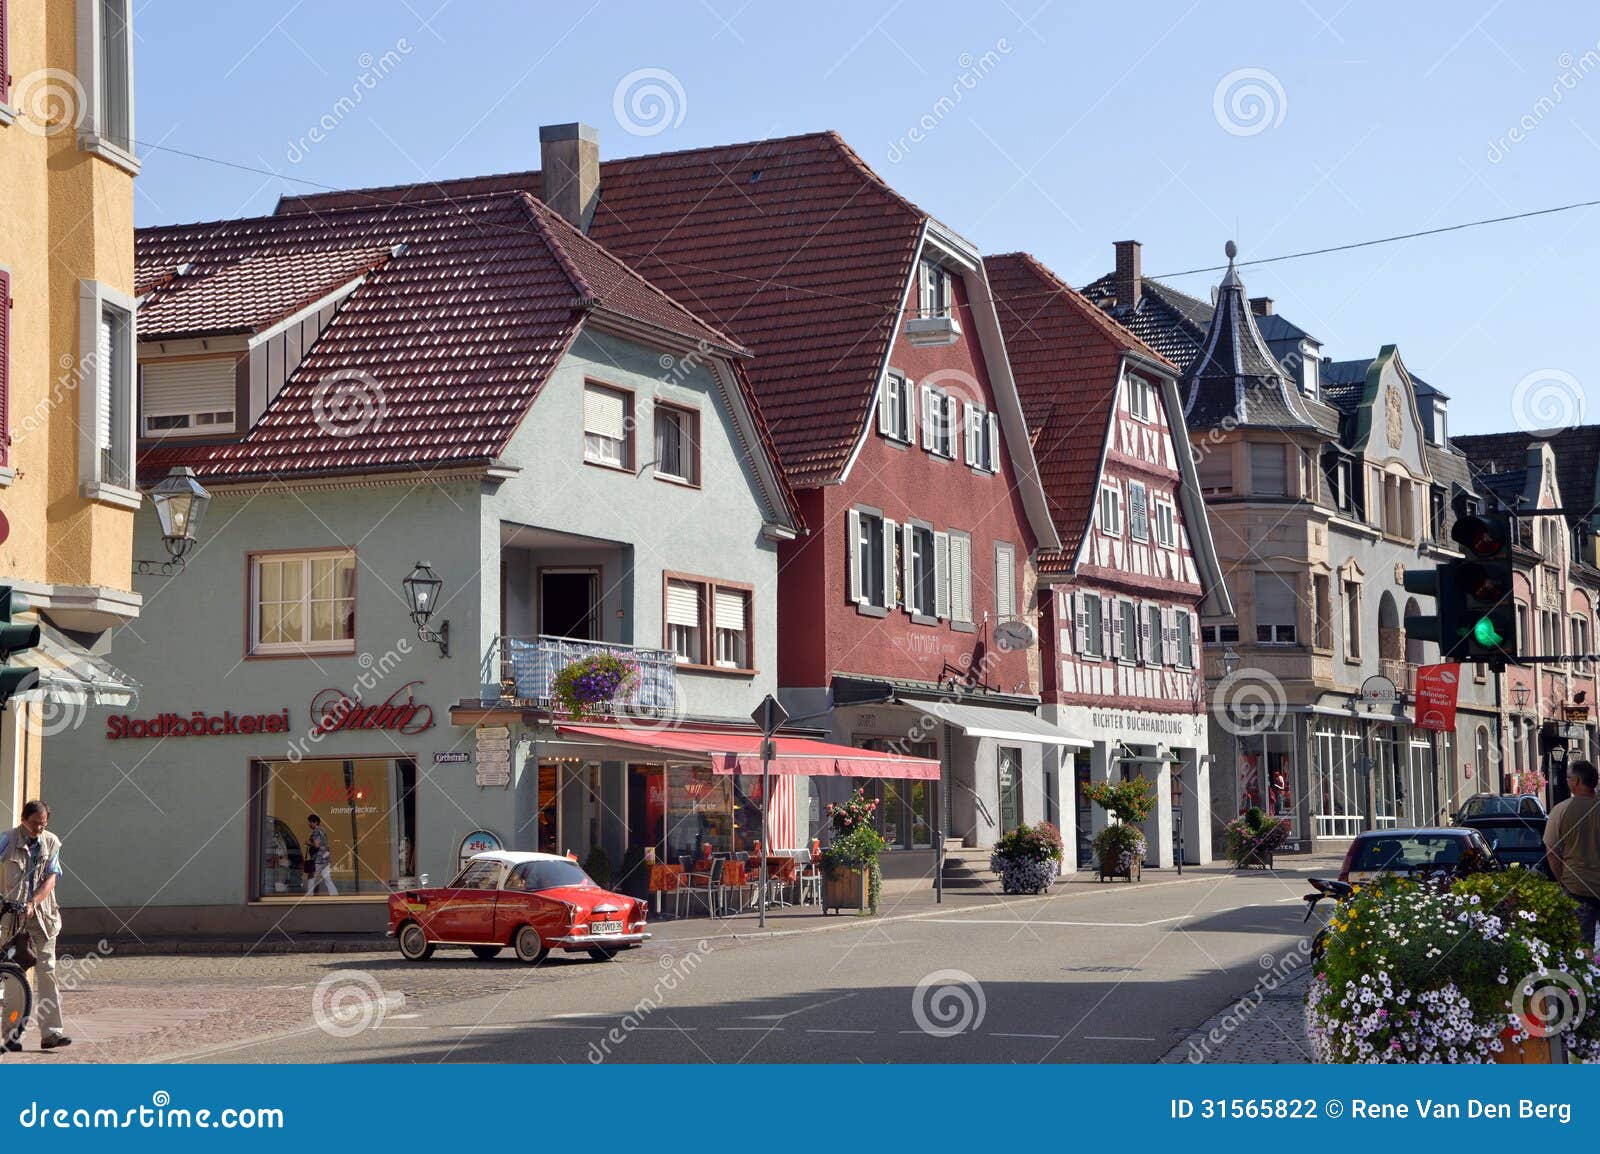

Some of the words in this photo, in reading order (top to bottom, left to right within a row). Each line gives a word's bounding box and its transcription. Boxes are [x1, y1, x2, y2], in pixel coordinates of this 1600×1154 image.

[106, 708, 290, 740] Stadtbäckerei
[1092, 713, 1123, 728] RICHTER
[1126, 717, 1182, 735] BUCHHANDLUNG
[330, 807, 353, 815] immer
